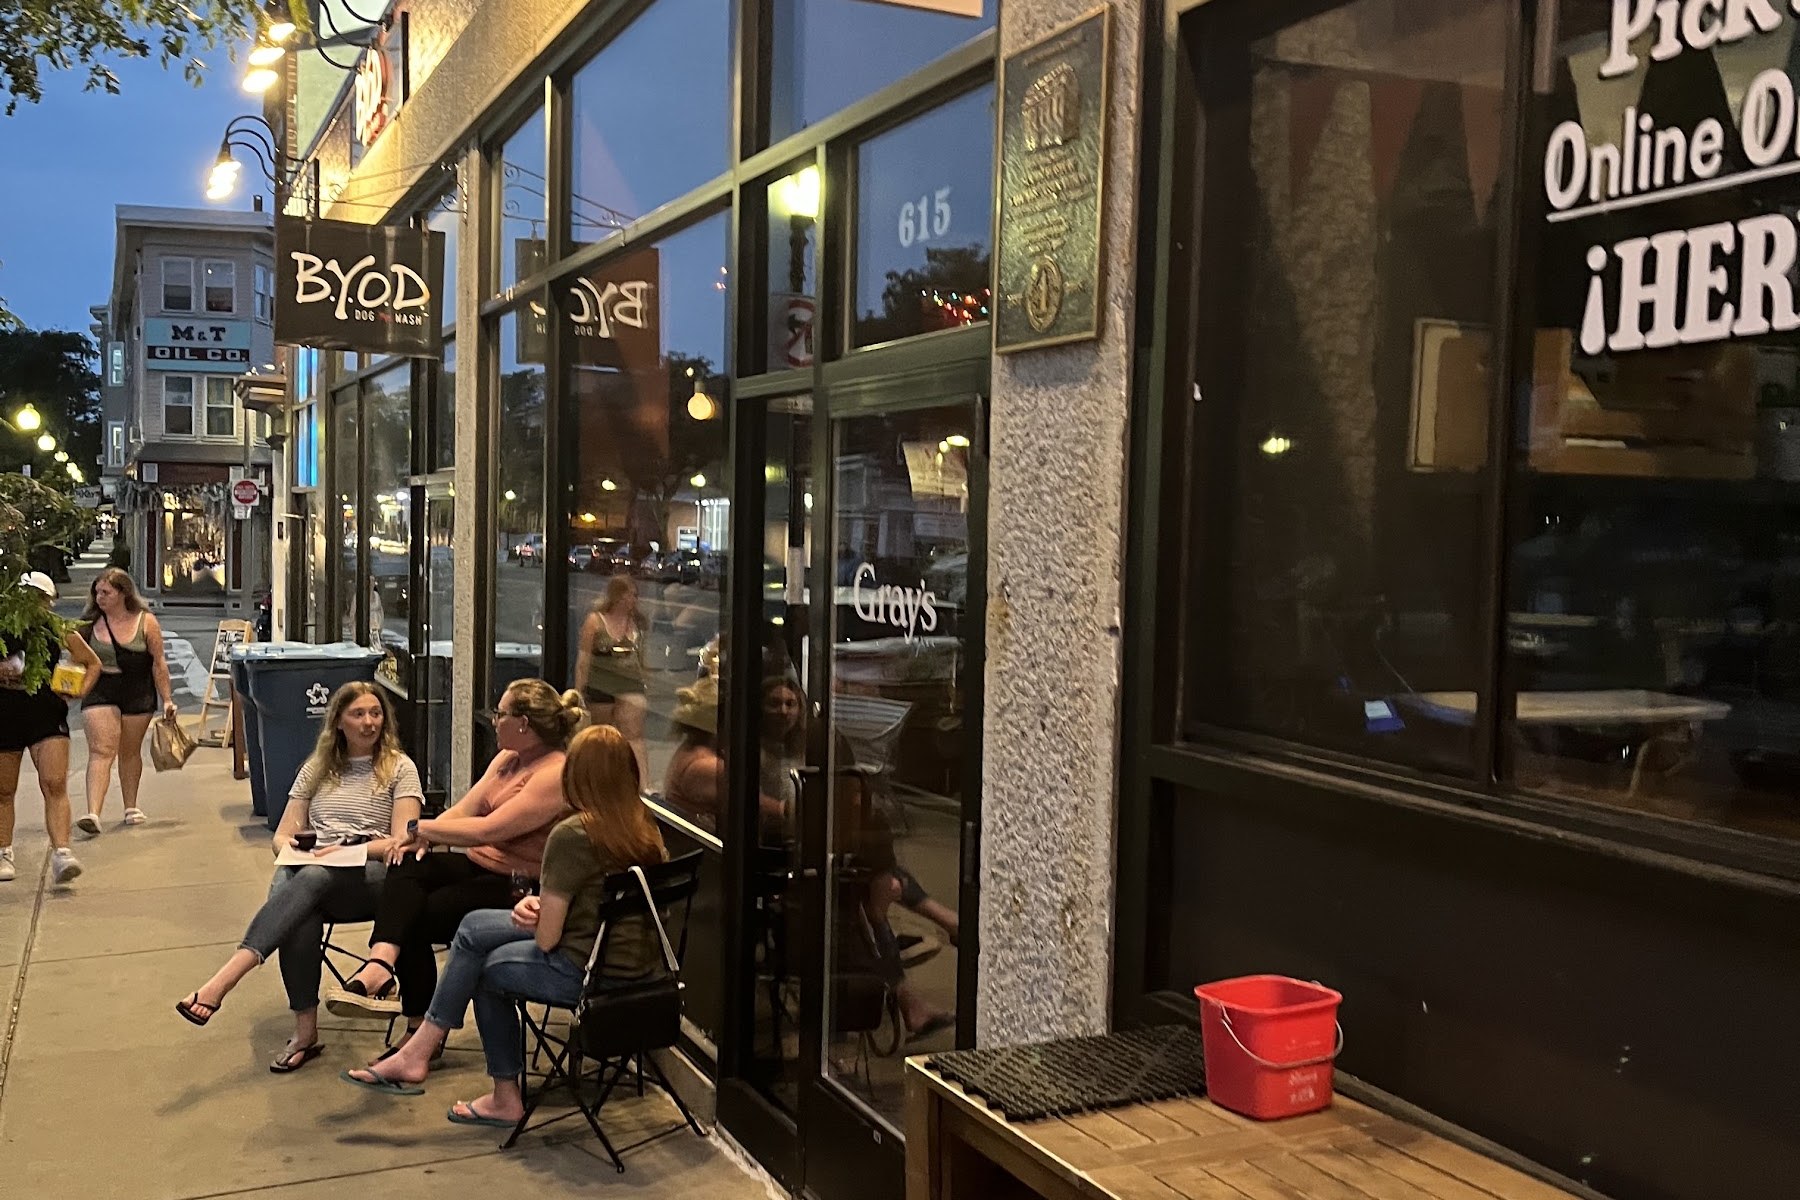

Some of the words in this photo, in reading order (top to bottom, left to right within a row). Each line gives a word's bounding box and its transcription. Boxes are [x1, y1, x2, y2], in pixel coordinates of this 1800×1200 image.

[1545, 105, 1725, 210] Online
[1741, 68, 1800, 166] O
[898, 185, 951, 248] 615
[1580, 212, 1800, 355] ¡HER
[171, 325, 194, 341] M
[209, 326, 226, 342] T
[354, 309, 375, 322] DOG
[394, 313, 422, 326] WASH
[155, 346, 198, 360] OIL
[207, 349, 246, 361] CO.
[853, 561, 938, 645] Gray's
